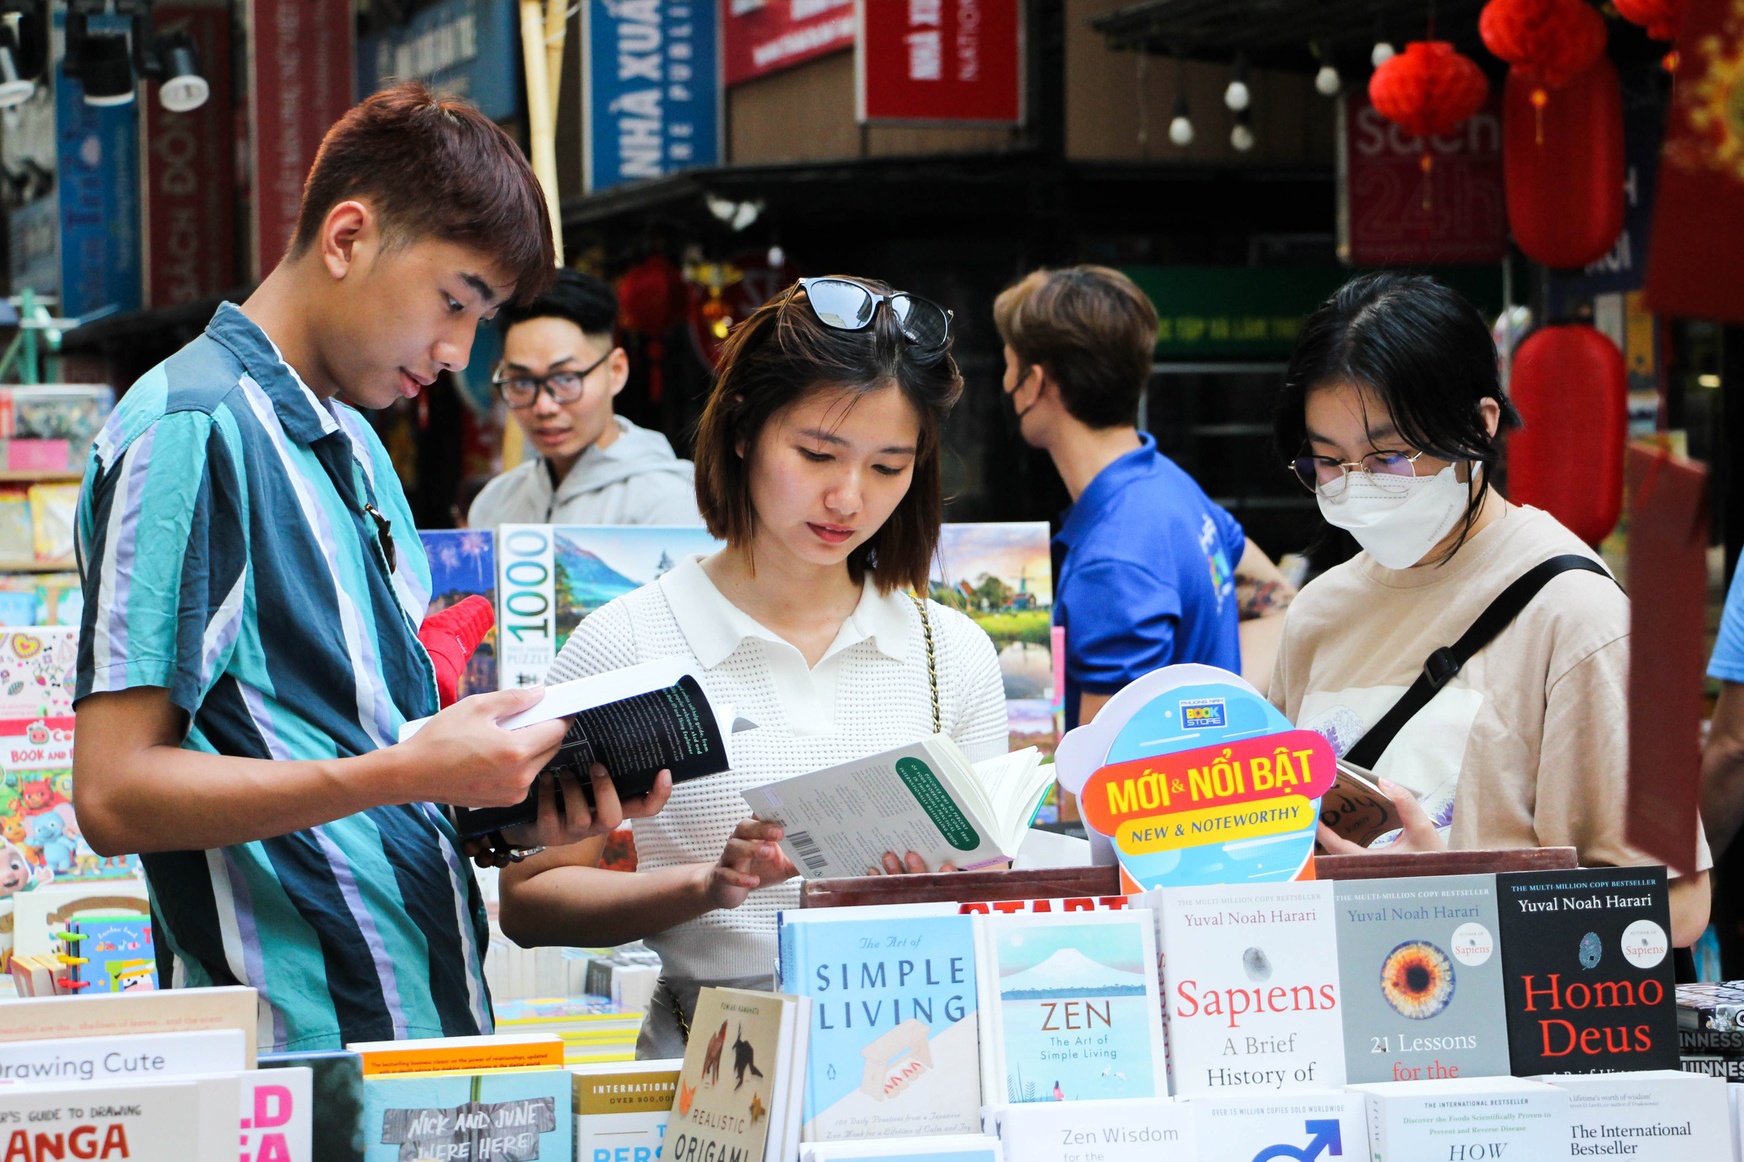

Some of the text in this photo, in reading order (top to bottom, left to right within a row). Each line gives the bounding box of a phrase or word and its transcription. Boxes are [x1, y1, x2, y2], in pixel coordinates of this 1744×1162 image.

[608, 88, 662, 177] NHÀ
[505, 530, 549, 643] 1000
[506, 653, 549, 665] PUZZLE
[1186, 706, 1220, 719] BOOK
[1187, 717, 1222, 727] STORE
[11, 750, 66, 763] BOOK AND
[1105, 746, 1313, 815] MỚI & NỔI BẬT
[1131, 805, 1301, 843] NEW & NOTEWORTHY
[1529, 882, 1588, 892] MULTI-MILLION
[1611, 878, 1656, 887] BESTSELLER
[1196, 896, 1252, 905] MULTI-MILLION
[1254, 895, 1274, 903] COPY
[1276, 894, 1321, 902] BESTSELLER
[1336, 888, 1490, 902] THE MULTI-MILLION COPY BESTSELLER
[1518, 894, 1652, 912] Yuval Noah Harari
[1184, 908, 1316, 927] Yuval Noah Harari
[1348, 904, 1480, 923] Yuval Noah Harari
[859, 934, 923, 950] The Art of
[1454, 945, 1490, 956] Sapiens
[1626, 946, 1664, 958] Sapiens
[816, 957, 965, 992] SIMPLE
[1521, 973, 1664, 1012] Homo
[819, 995, 966, 1030] LIVING
[1177, 980, 1336, 1028] Sapiens
[1040, 1000, 1113, 1031] ZEN
[1050, 1034, 1108, 1046] The Art of
[1222, 1032, 1297, 1056] A Brief
[1370, 1034, 1477, 1053] 21 Lessons
[1538, 1019, 1652, 1057] Deus
[1040, 1048, 1117, 1062] Simple Living
[0, 1052, 166, 1080] rawing Cute
[1392, 1060, 1460, 1082] for the
[1207, 1062, 1316, 1090] History of
[593, 1081, 676, 1094] INTERNATIONA
[1439, 1100, 1488, 1108] INTERNATIONAL
[1490, 1098, 1529, 1106] BESTSELLER
[1573, 1094, 1600, 1102] lifetime's
[28, 1108, 62, 1122] GUIDE
[69, 1107, 84, 1118] TO
[90, 1104, 142, 1118] DRAWING
[1212, 1104, 1345, 1116] OVER 15 MILLION COPIES SOLD WORLDWIDE
[1472, 1113, 1516, 1122] Scientifically
[408, 1102, 545, 1139] NICK AND JUNE
[692, 1108, 745, 1134] REALISTIC
[944, 1124, 957, 1132] and
[1061, 1126, 1179, 1146] Zen Wisdom
[1429, 1128, 1456, 1136] Prevent
[1472, 1126, 1498, 1134] Reverse
[1570, 1122, 1692, 1138] The International
[418, 1132, 533, 1162] WERE HERE
[674, 1134, 749, 1162] ORIGAMI
[1450, 1142, 1508, 1162] HOW
[1570, 1140, 1639, 1156] Bestseller
[1063, 1152, 1104, 1162] for the
